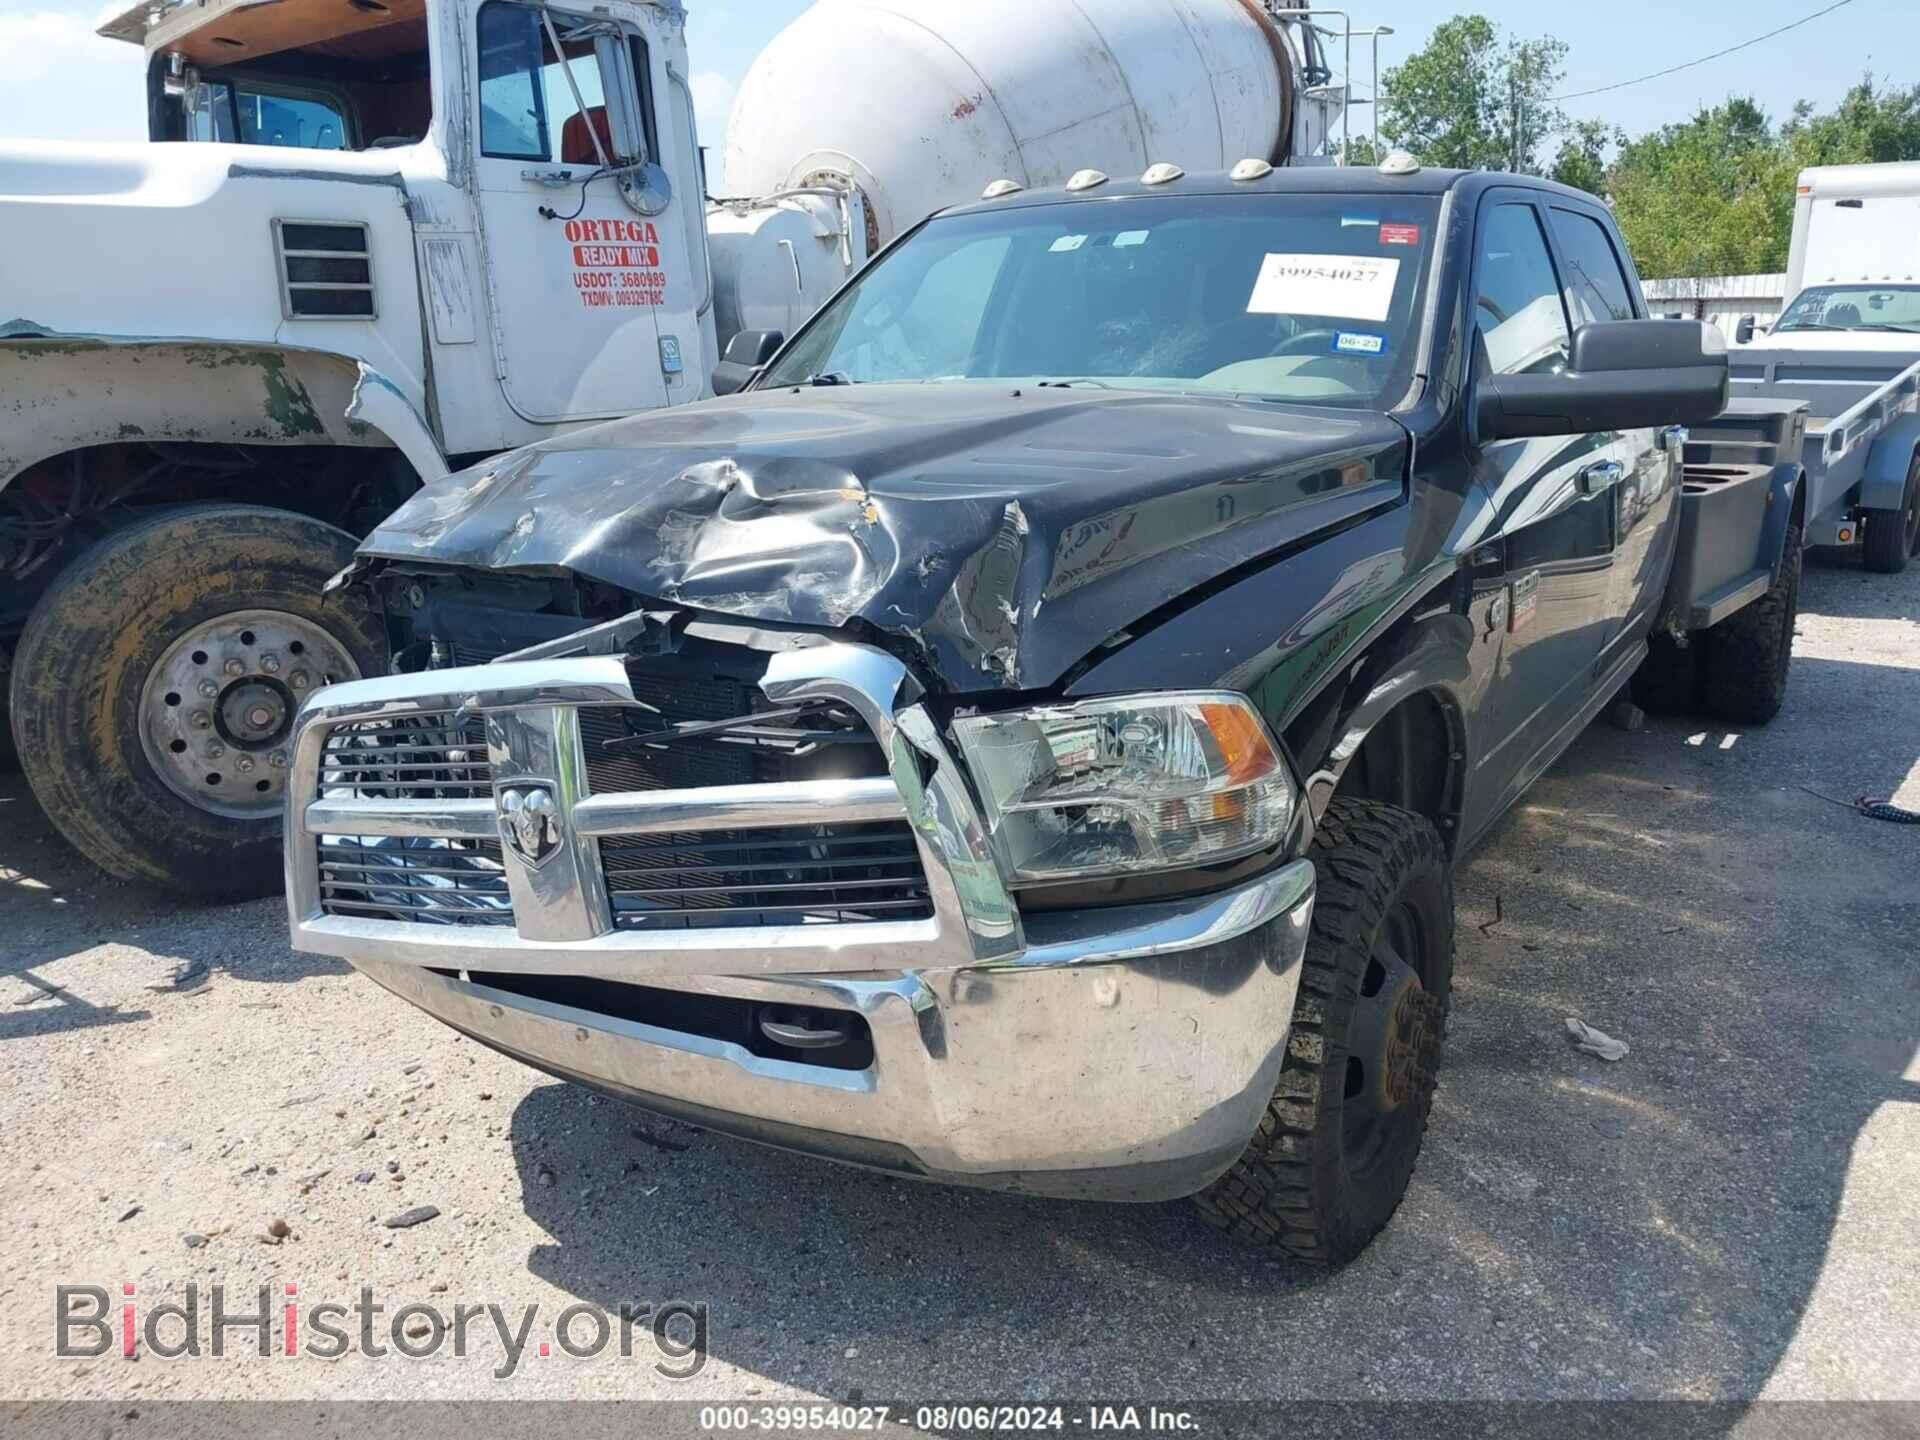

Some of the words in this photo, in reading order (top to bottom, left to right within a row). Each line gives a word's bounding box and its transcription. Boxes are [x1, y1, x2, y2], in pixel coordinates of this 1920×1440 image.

[564, 219, 660, 244] ORTEGA
[581, 247, 624, 266] READY
[626, 247, 652, 265] MIX
[573, 271, 618, 288] USDOT:
[620, 272, 666, 288] 3680989
[1272, 266, 1379, 282] 39954027
[581, 291, 615, 306] TXDMV:
